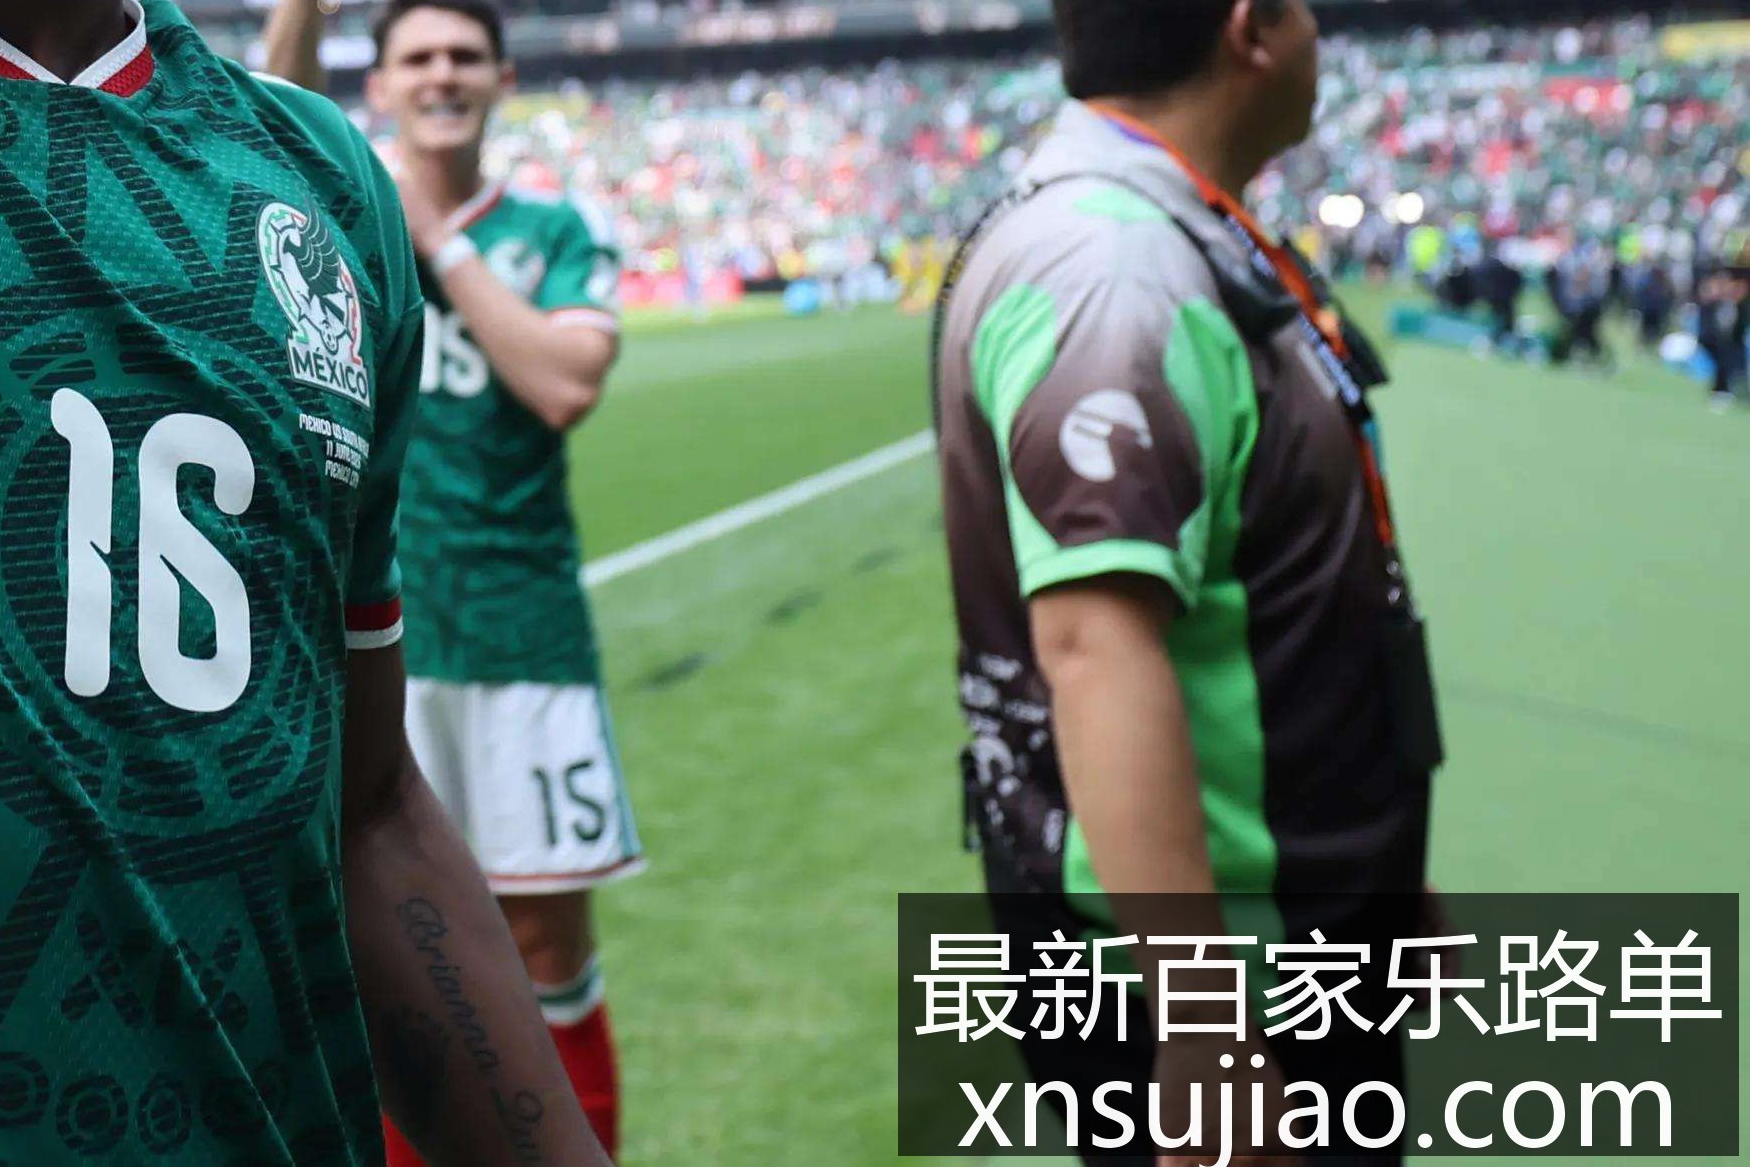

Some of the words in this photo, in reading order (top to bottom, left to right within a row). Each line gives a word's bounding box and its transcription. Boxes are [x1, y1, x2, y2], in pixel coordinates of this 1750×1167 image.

[295, 347, 368, 397] MÉXICO
[51, 388, 255, 712] 16
[532, 759, 607, 850] 15
